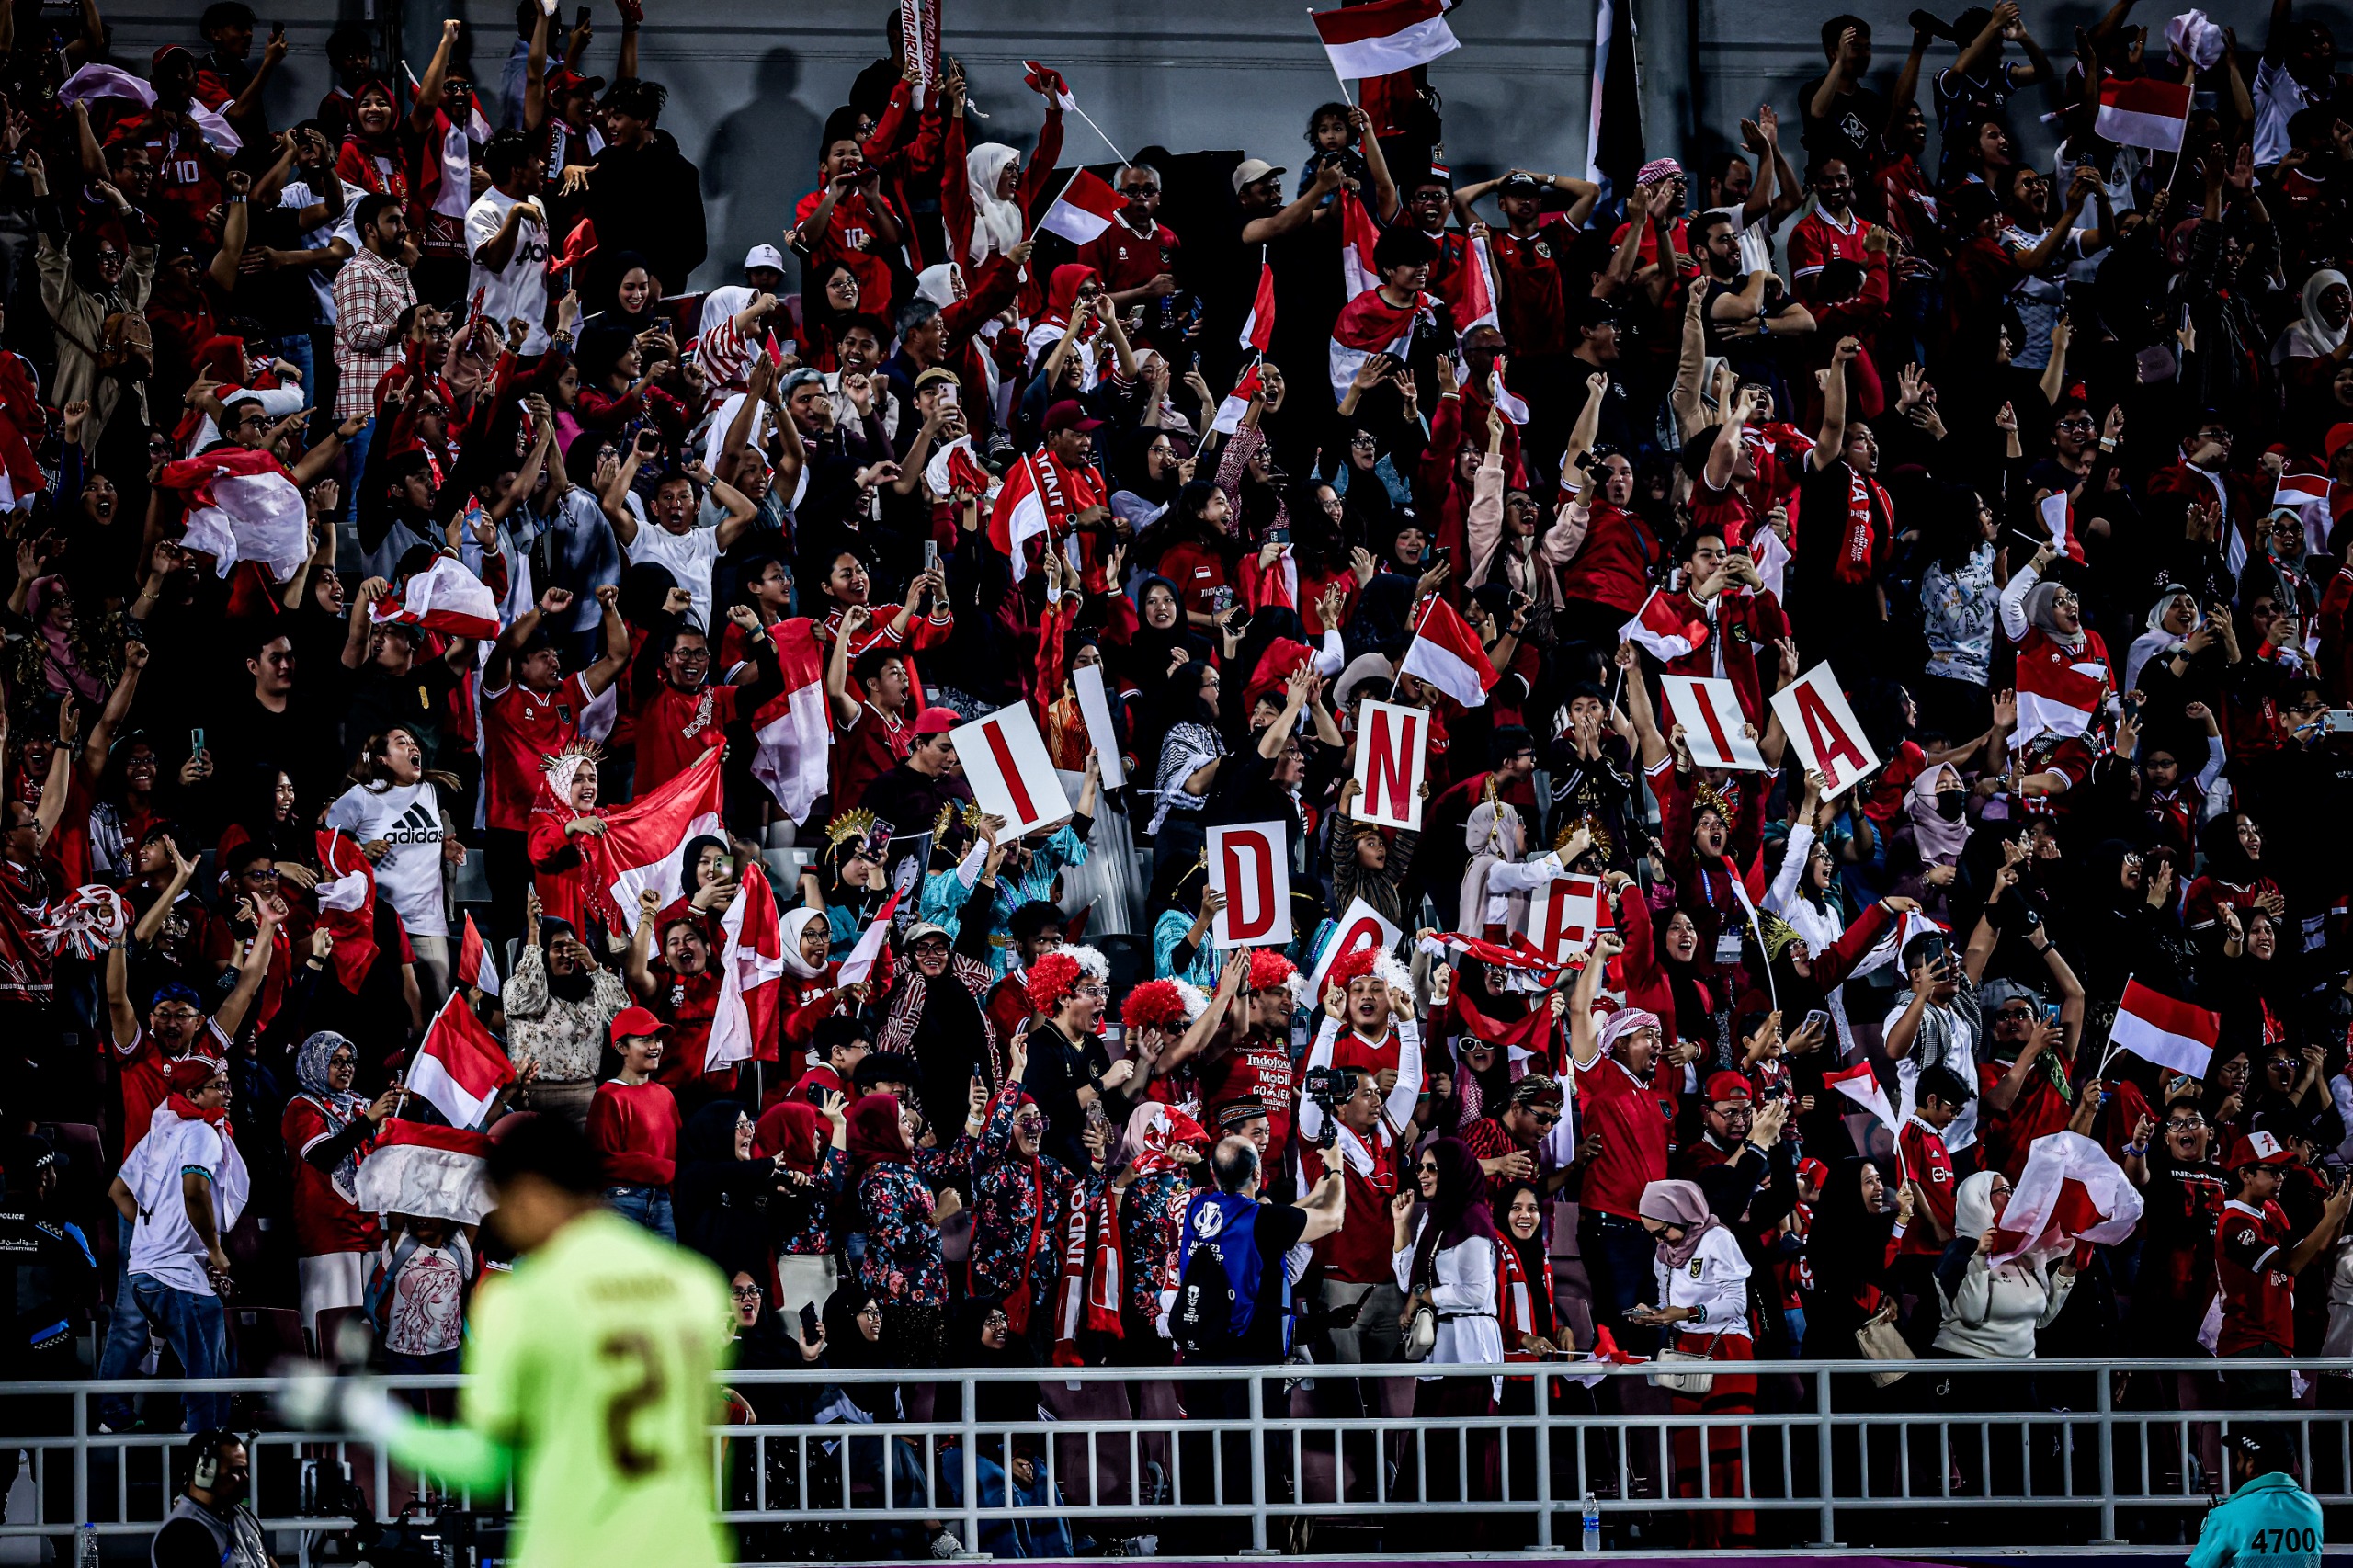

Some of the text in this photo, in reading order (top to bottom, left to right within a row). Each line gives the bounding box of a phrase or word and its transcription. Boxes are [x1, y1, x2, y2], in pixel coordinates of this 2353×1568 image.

[902, 0, 920, 74] KITAGARUD
[175, 160, 199, 184] 10
[844, 227, 866, 252] 10
[1858, 524, 1866, 546] ASIAN
[1690, 682, 1735, 764] I
[1793, 680, 1869, 790] A
[982, 720, 1039, 825] I
[1364, 709, 1417, 823] N
[383, 828, 443, 846] adidas
[1222, 830, 1276, 940] D
[1259, 1070, 1290, 1085] Mobil
[596, 1327, 699, 1482] 2
[2251, 1527, 2316, 1554] 4700
